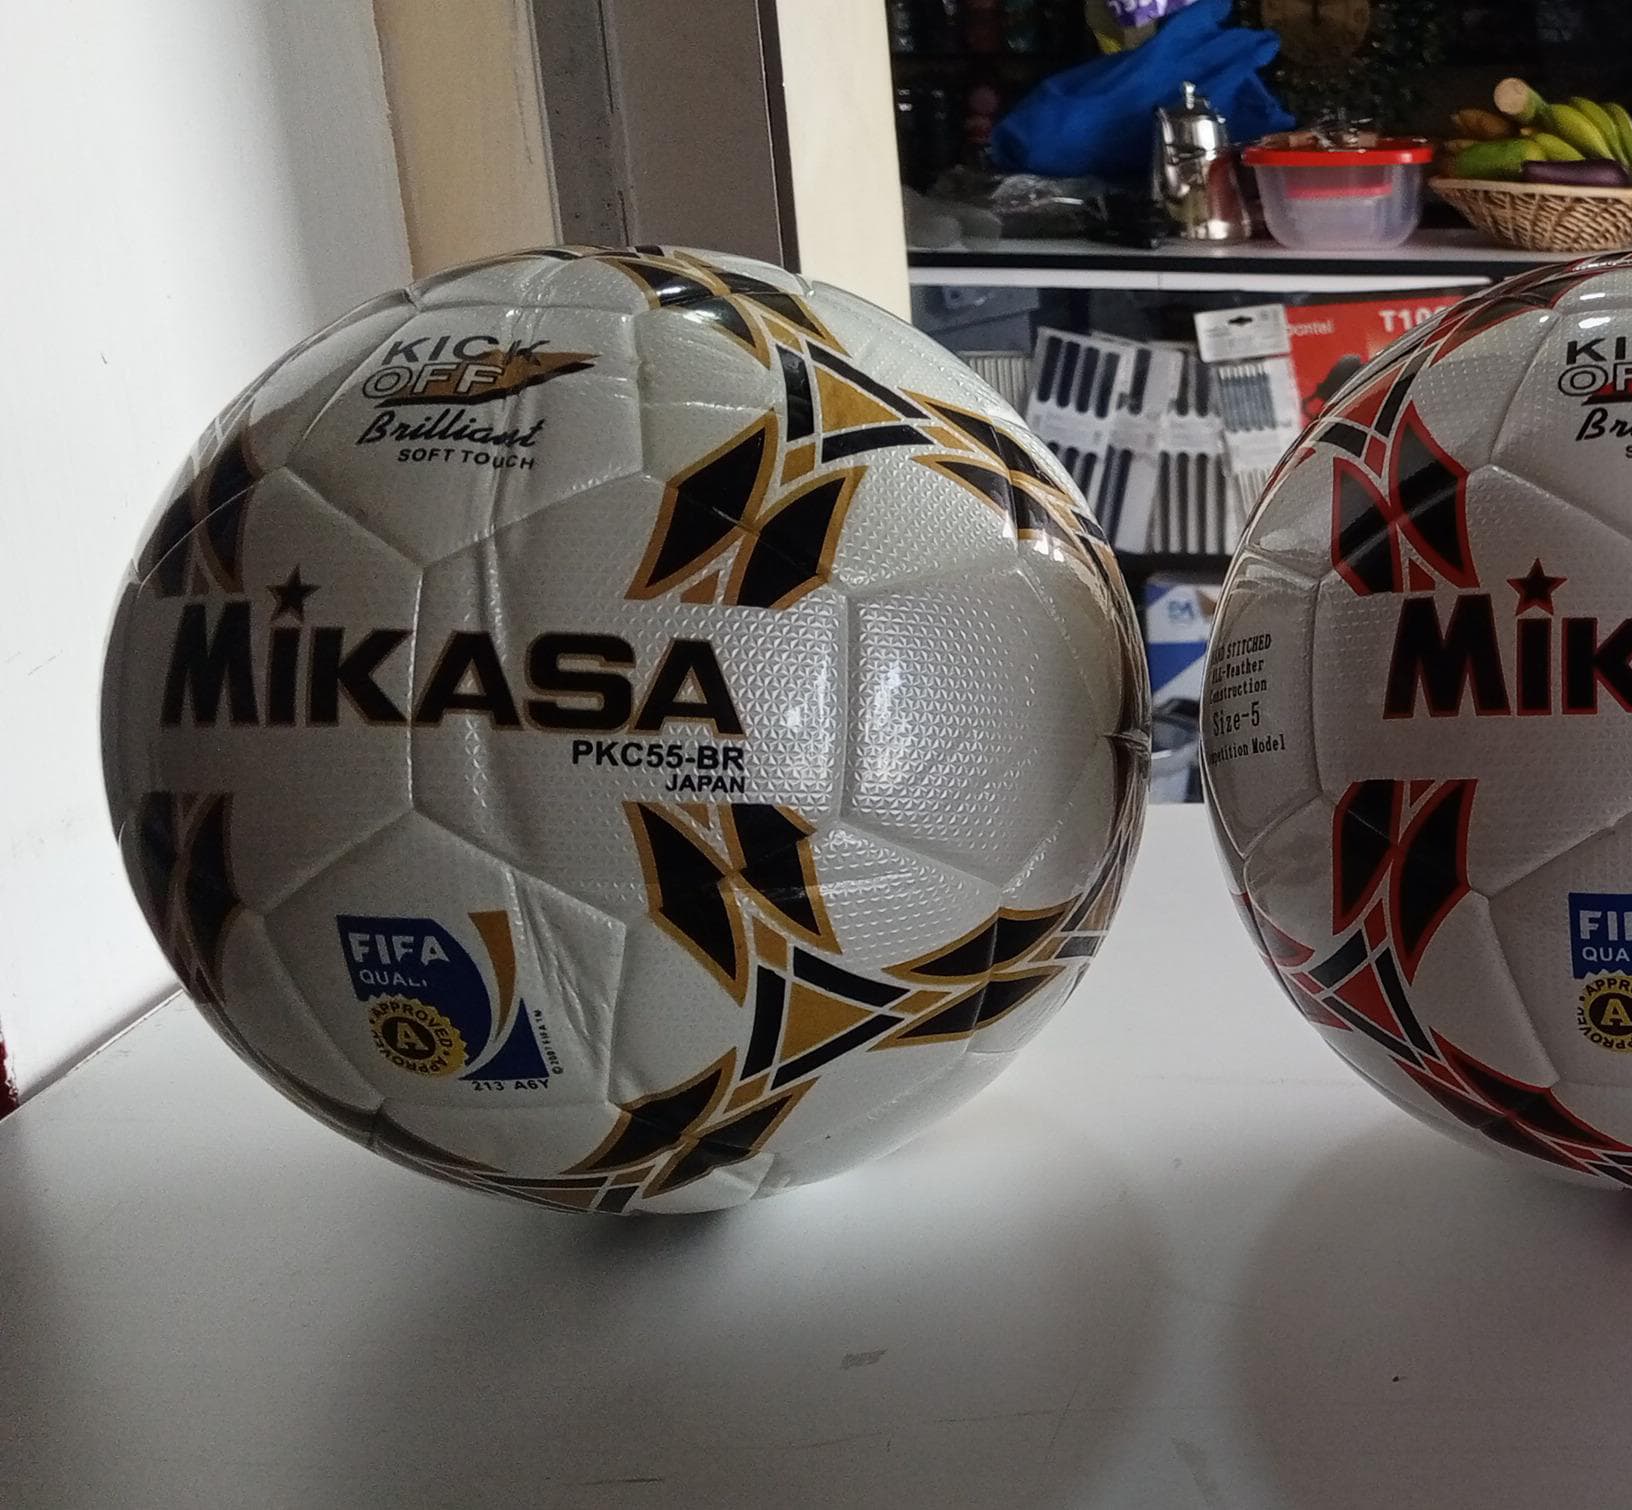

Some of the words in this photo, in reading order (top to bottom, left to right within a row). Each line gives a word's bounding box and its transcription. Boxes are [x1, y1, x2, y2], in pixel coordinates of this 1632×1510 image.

[381, 335, 551, 367] KICK
[362, 362, 503, 399] OFF
[355, 408, 545, 447] Brilliant
[398, 448, 455, 463] SOFT
[462, 450, 535, 470] TOUCH
[1227, 634, 1272, 659] STITCHED
[1213, 701, 1260, 736] Size-5
[572, 740, 744, 771] PKC55-BR
[1252, 734, 1285, 754] Model
[665, 774, 745, 794] JAPAN
[348, 932, 450, 966] FIFA
[472, 1080, 504, 1091] 213
[514, 1079, 550, 1090] A6Y
